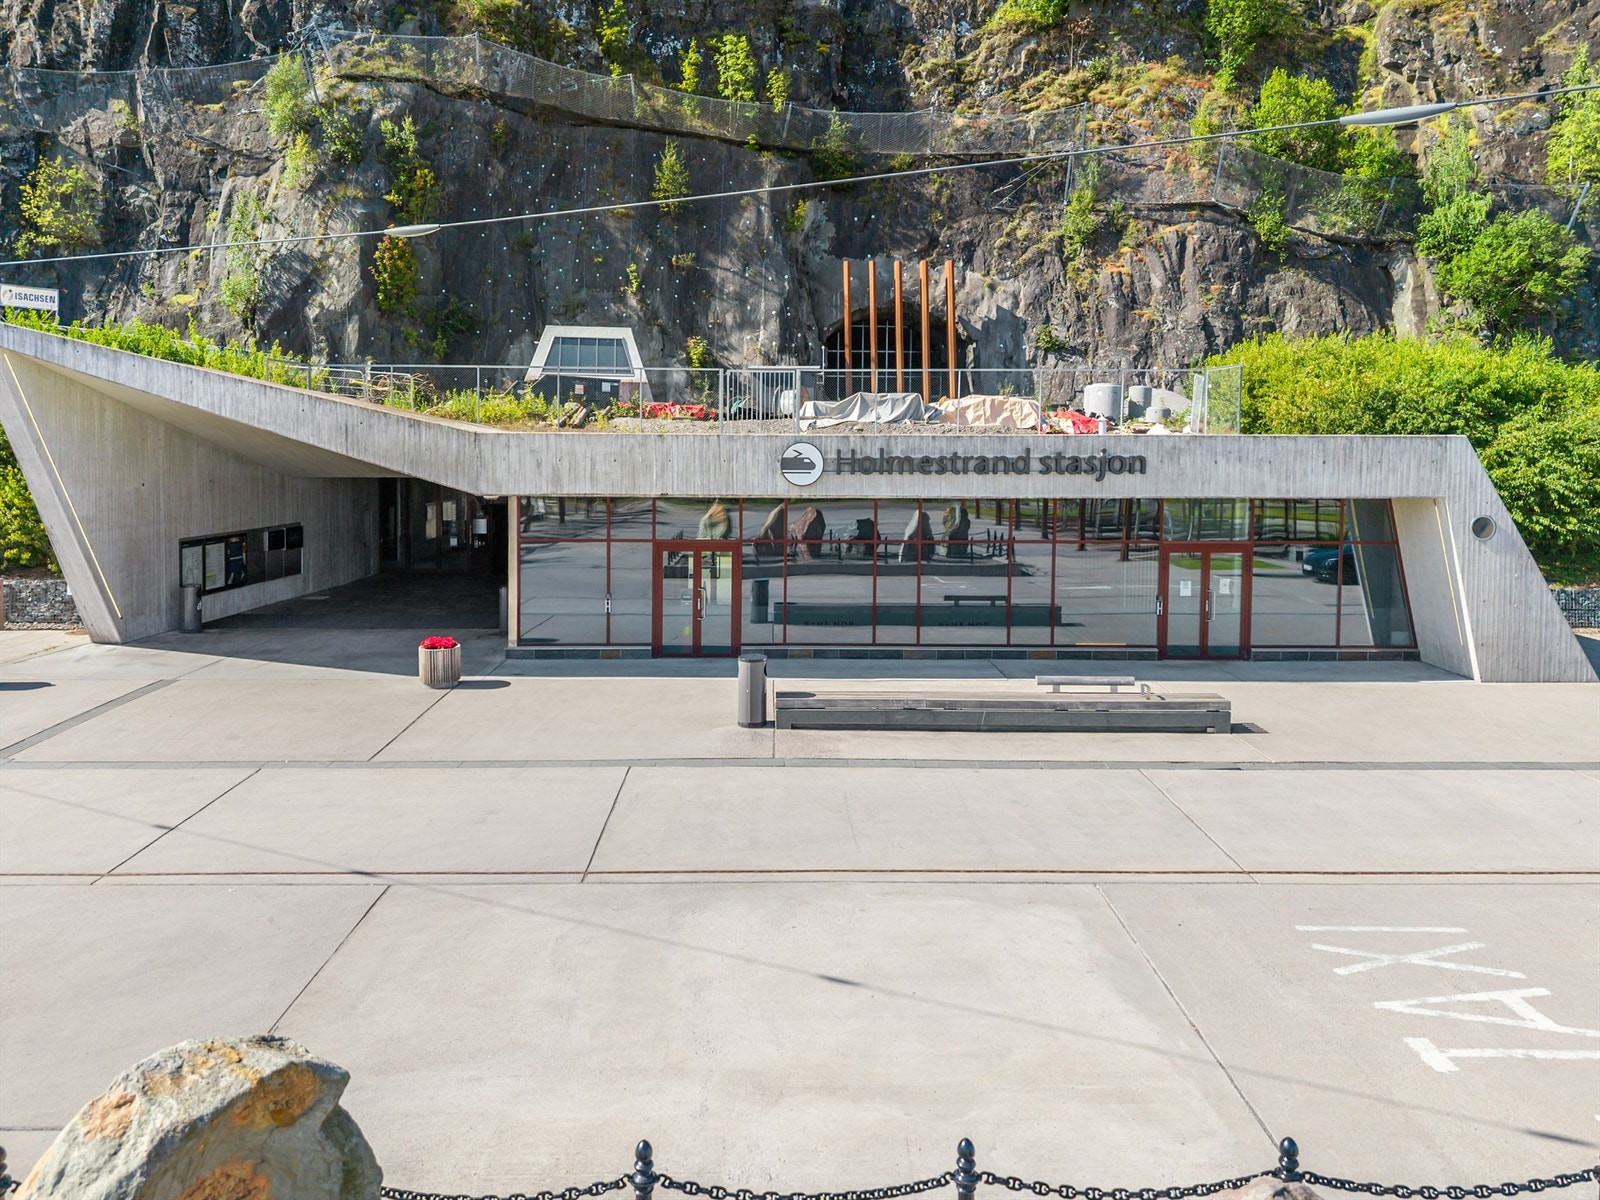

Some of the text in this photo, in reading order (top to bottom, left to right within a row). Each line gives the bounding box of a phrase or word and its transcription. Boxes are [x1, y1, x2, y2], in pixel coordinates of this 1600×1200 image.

[15, 292, 55, 303] ISACHSEN
[835, 448, 1147, 482] Holmestrand stasjon
[1294, 924, 1600, 1074] TAXI
